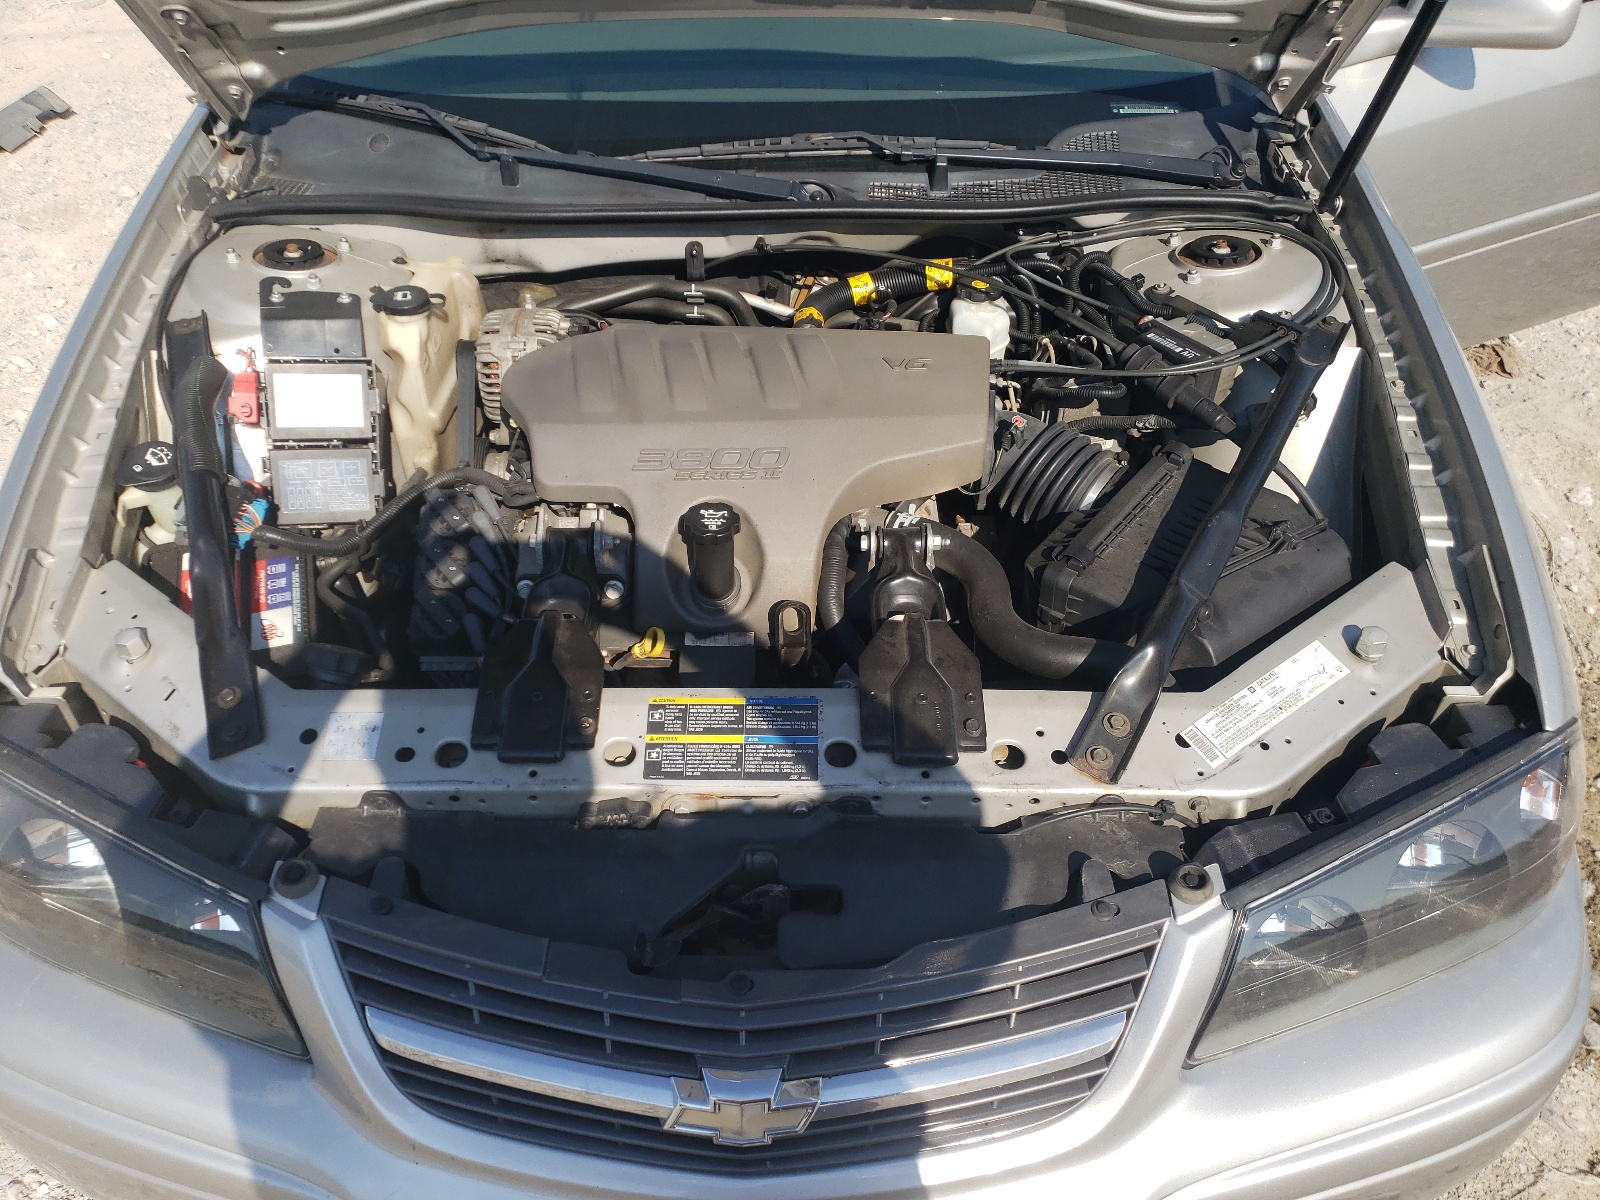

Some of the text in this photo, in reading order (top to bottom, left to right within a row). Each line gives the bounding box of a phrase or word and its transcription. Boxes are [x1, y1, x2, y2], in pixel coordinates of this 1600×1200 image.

[881, 357, 932, 371] V6
[632, 447, 790, 471] 3800
[674, 469, 782, 481] SERIES II
